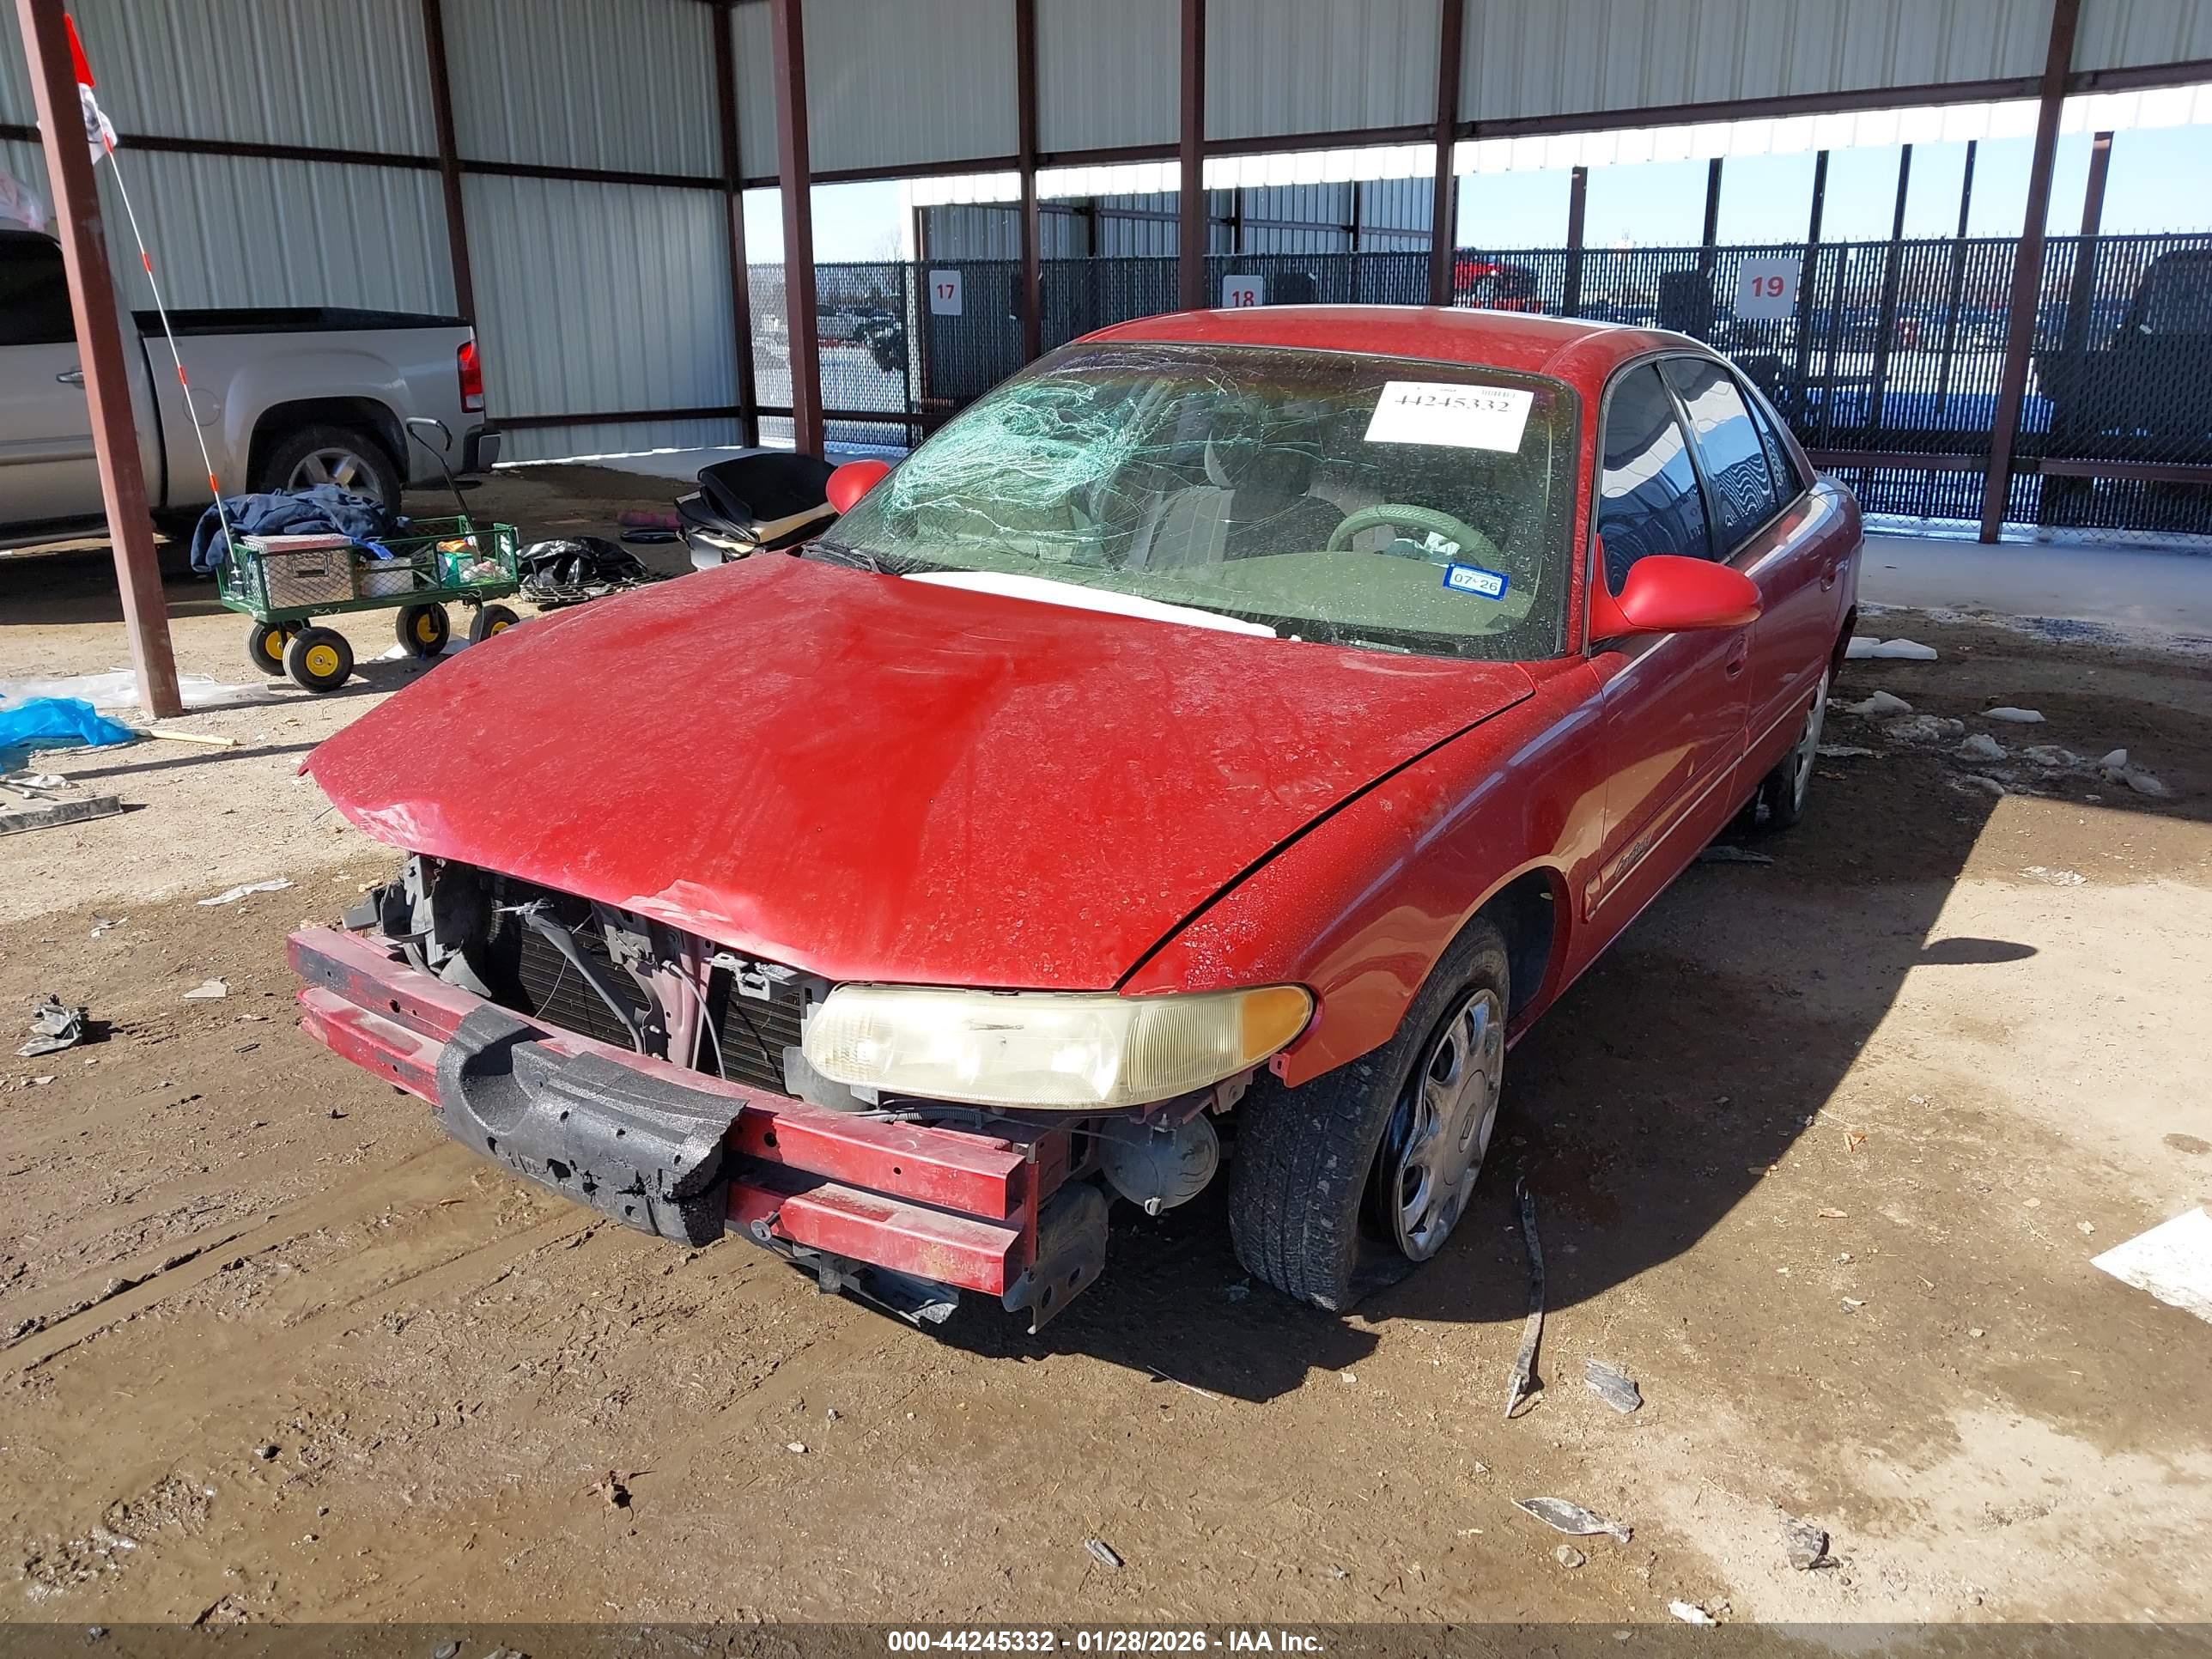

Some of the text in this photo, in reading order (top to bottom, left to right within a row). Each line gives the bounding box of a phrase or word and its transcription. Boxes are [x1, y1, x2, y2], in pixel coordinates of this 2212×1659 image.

[937, 283, 955, 300] 17
[1752, 276, 1784, 298] 19
[1232, 290, 1255, 307] 18
[1395, 394, 1510, 413] 44245332
